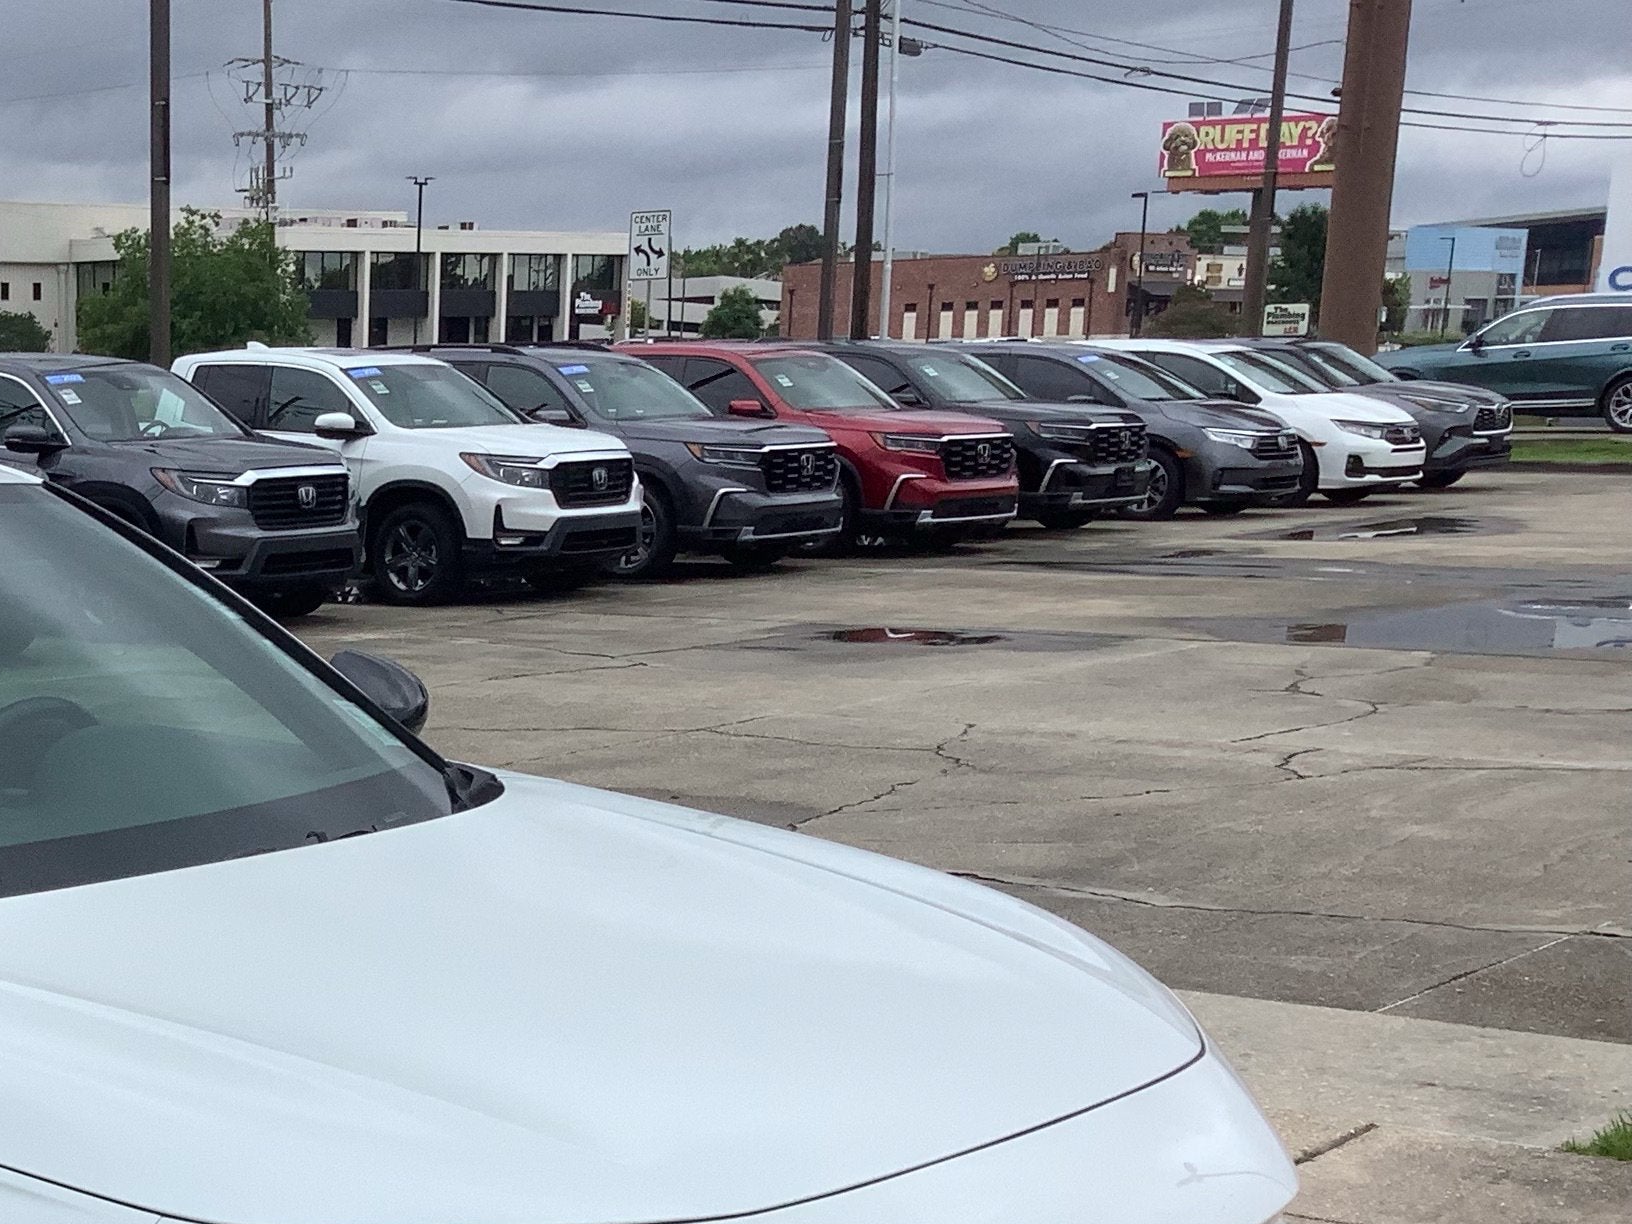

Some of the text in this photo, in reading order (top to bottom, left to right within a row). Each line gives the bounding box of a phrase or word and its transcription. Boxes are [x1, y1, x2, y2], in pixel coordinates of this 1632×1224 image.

[1198, 124, 1258, 149] RUFF
[634, 214, 668, 224] CENTER
[638, 224, 662, 234] LANE
[637, 267, 660, 277] ONLY
